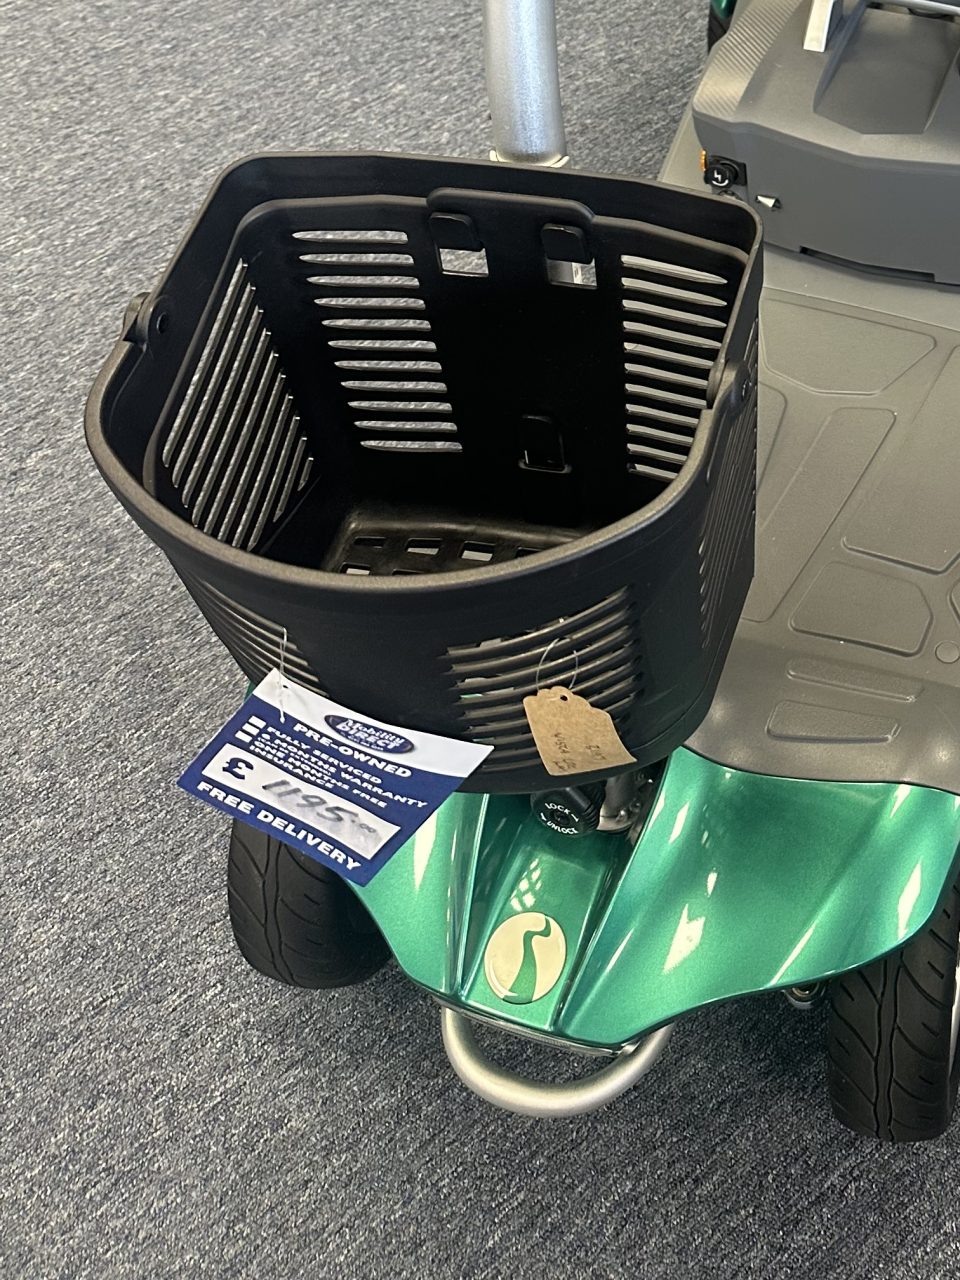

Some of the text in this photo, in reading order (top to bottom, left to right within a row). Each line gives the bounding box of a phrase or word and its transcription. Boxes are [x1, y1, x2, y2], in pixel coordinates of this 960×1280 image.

[293, 723, 413, 778] PRE-OWNED
[335, 723, 401, 750] DIRECT
[343, 719, 406, 744] Mobility
[221, 757, 255, 781] £
[249, 745, 335, 789] INSURANCE
[253, 740, 388, 809] ONE MONTHS FREE
[267, 727, 312, 751] FULLY
[313, 749, 382, 784] SERVICED
[274, 739, 336, 774] MONTHS
[340, 772, 429, 808] WARRANTY
[196, 780, 363, 872] FREE DELIVERY
[544, 802, 571, 814] LOCK
[546, 821, 579, 835] UNLOCK
